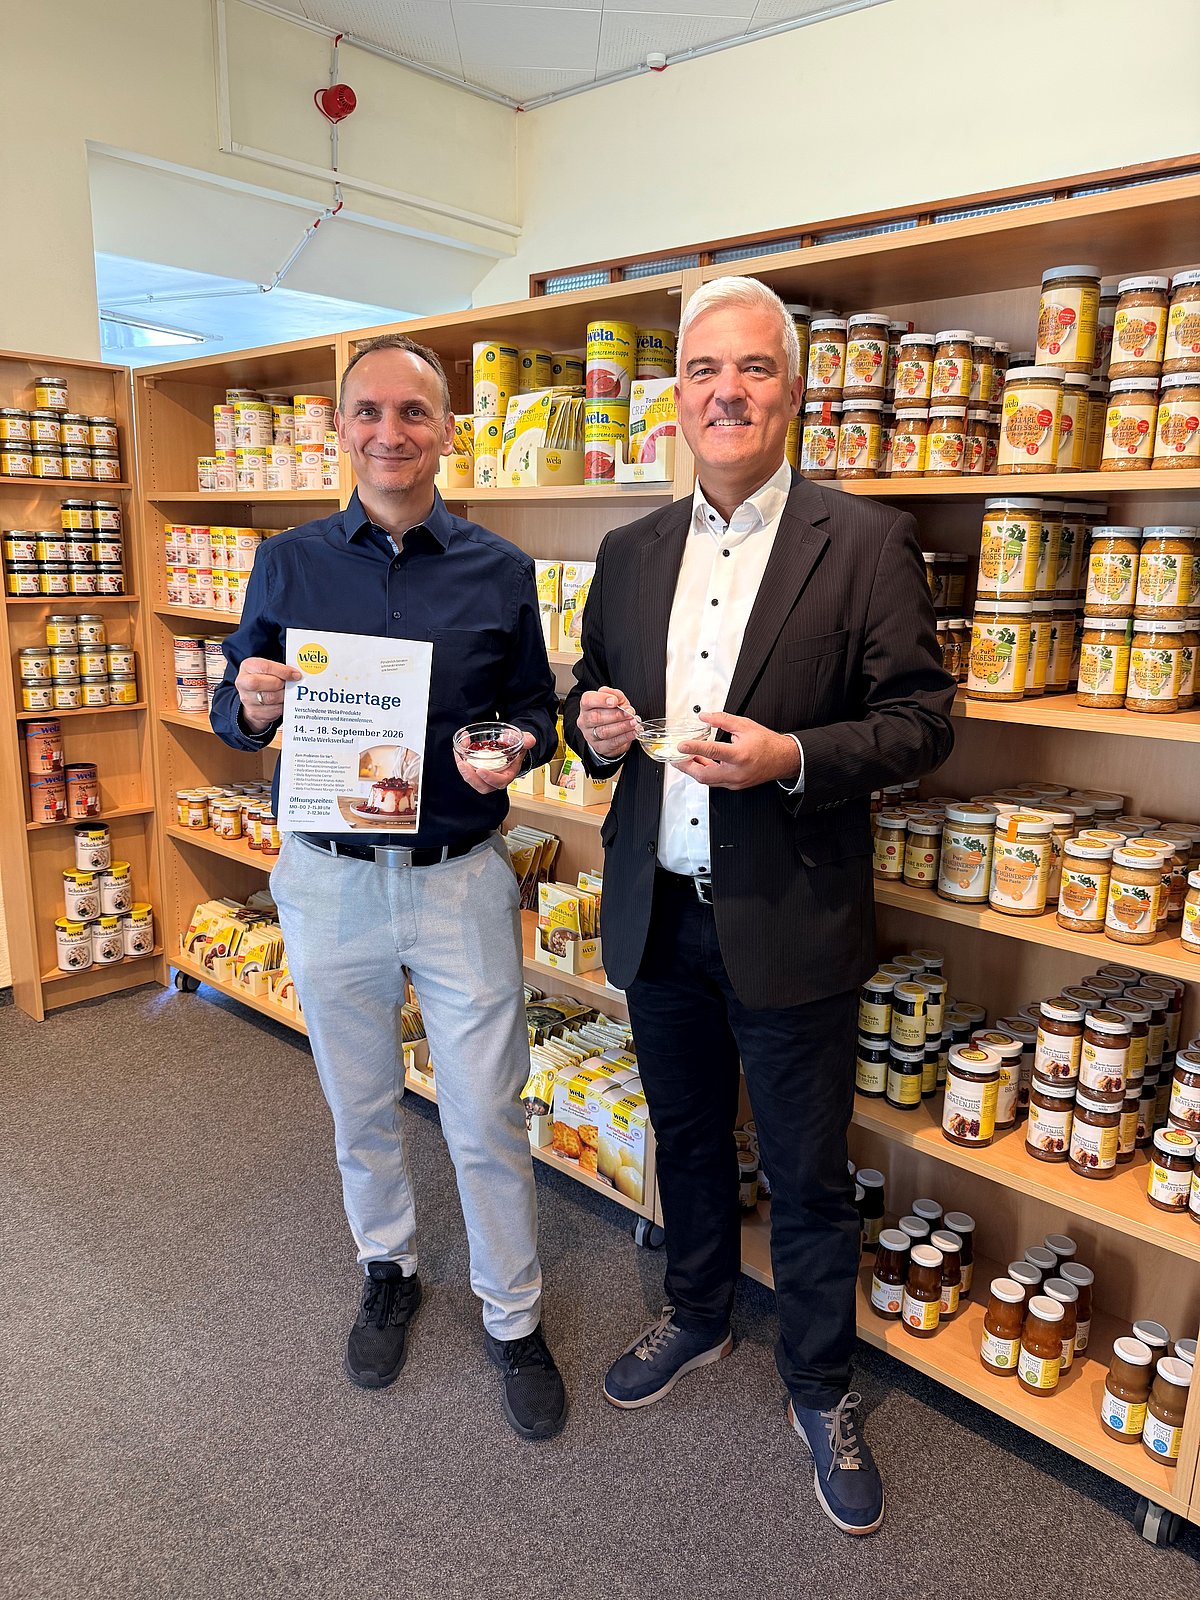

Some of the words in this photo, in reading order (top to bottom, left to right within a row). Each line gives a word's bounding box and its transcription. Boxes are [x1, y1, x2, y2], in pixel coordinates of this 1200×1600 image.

[587, 328, 615, 342] wela
[632, 403, 677, 415] CREMESUPP
[1005, 399, 1018, 408] wela
[586, 412, 610, 424] wela
[455, 462, 470, 470] wela
[546, 456, 562, 464] wela
[299, 650, 328, 664] wela
[297, 686, 401, 710] Probiertage
[294, 725, 307, 733] 14.
[317, 726, 329, 734] 18.
[331, 727, 380, 737] September
[382, 730, 404, 738] 2026
[570, 1088, 585, 1099] wela
[622, 1098, 638, 1108] wela
[947, 1094, 980, 1109] BRATENJUS
[613, 1112, 629, 1124] wela
[1155, 1170, 1168, 1180] wela
[1109, 1400, 1126, 1413] FISCH
[1110, 1407, 1126, 1418] FOND
[1153, 1425, 1171, 1437] FISCH
[1153, 1431, 1170, 1443] FOND
